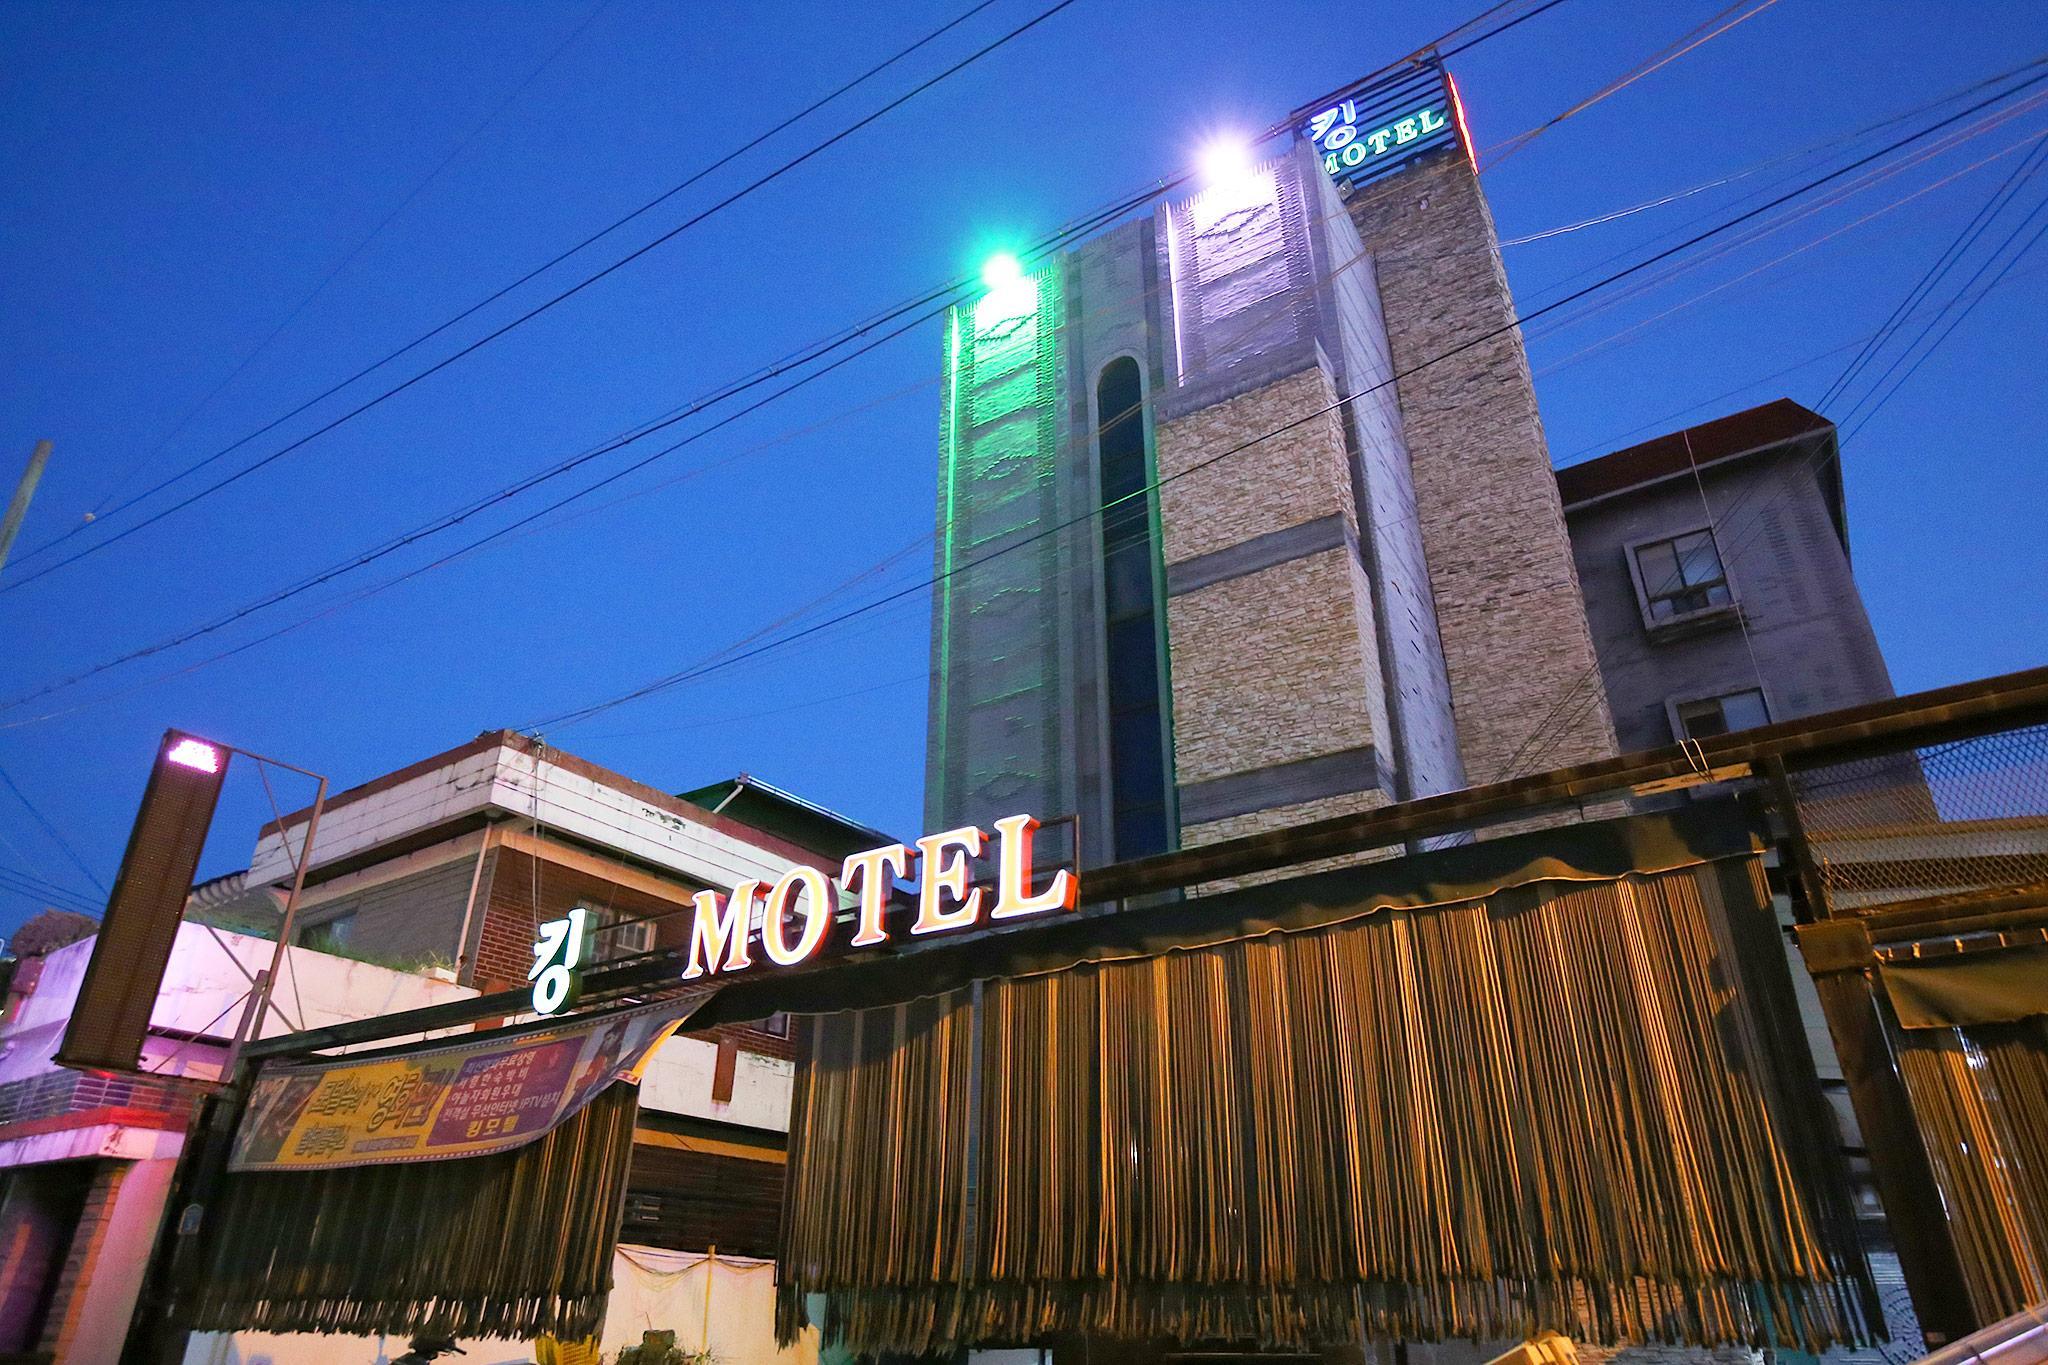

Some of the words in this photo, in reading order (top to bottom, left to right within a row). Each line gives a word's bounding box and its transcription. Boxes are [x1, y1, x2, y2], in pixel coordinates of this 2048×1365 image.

[1311, 100, 1357, 150] 킹
[681, 813, 1078, 980] MOTEL
[528, 908, 585, 1015] 킹
